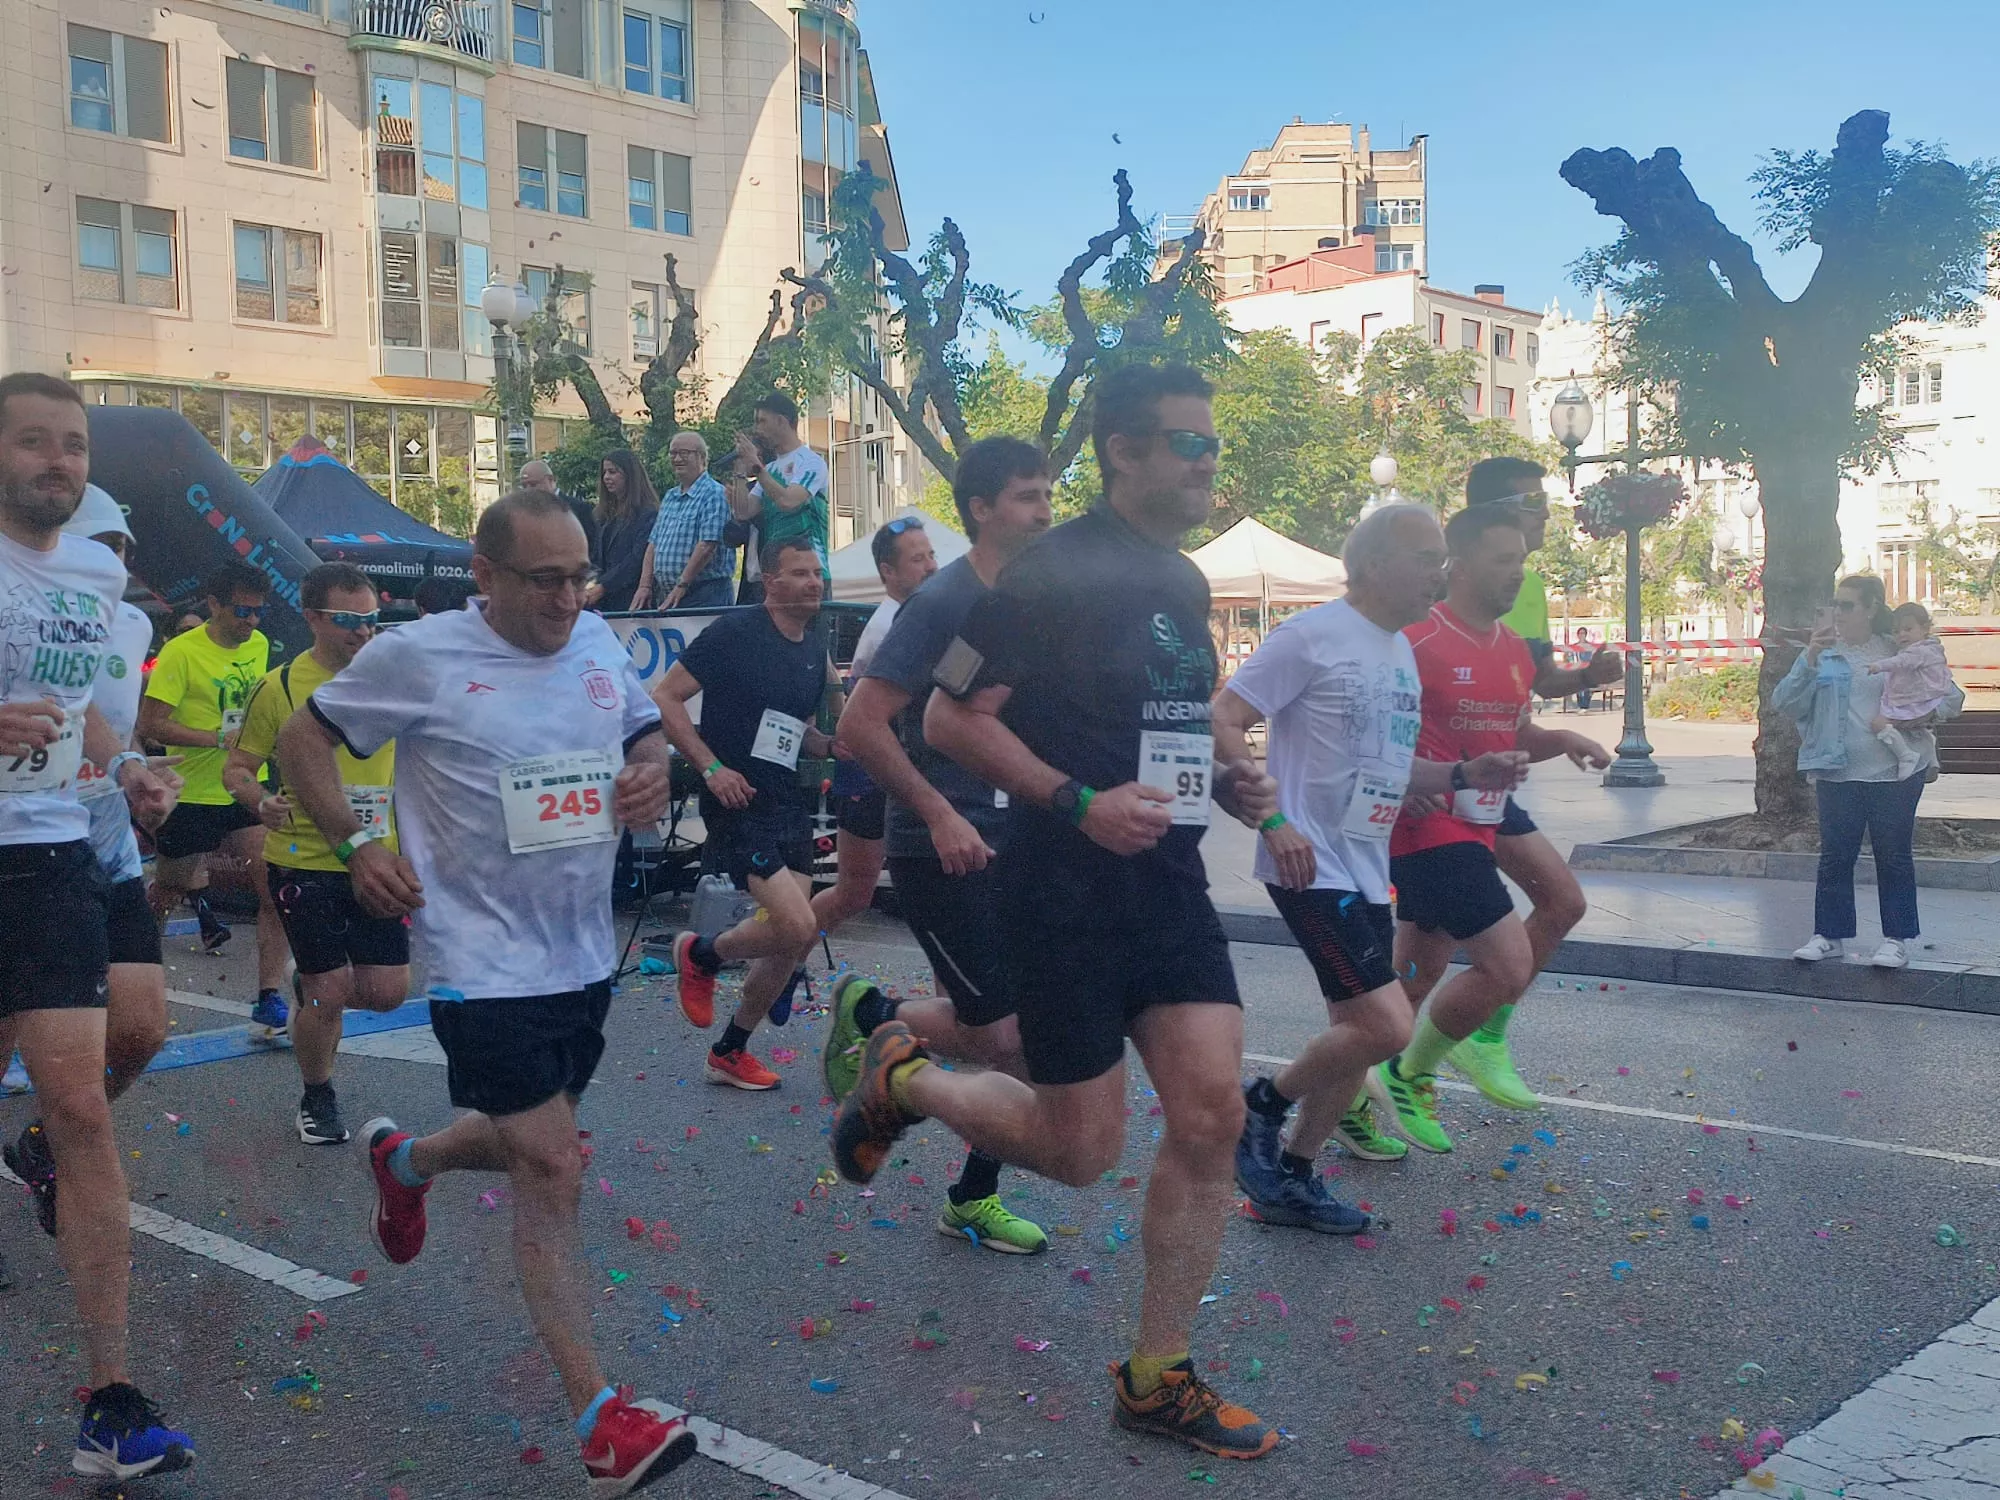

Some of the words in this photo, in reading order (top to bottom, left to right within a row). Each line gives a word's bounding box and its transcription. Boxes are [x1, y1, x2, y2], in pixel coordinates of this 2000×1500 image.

[186, 483, 303, 613] CroNoLimit
[776, 735, 793, 753] 56
[1177, 770, 1205, 798] 93
[536, 788, 602, 822] 245
